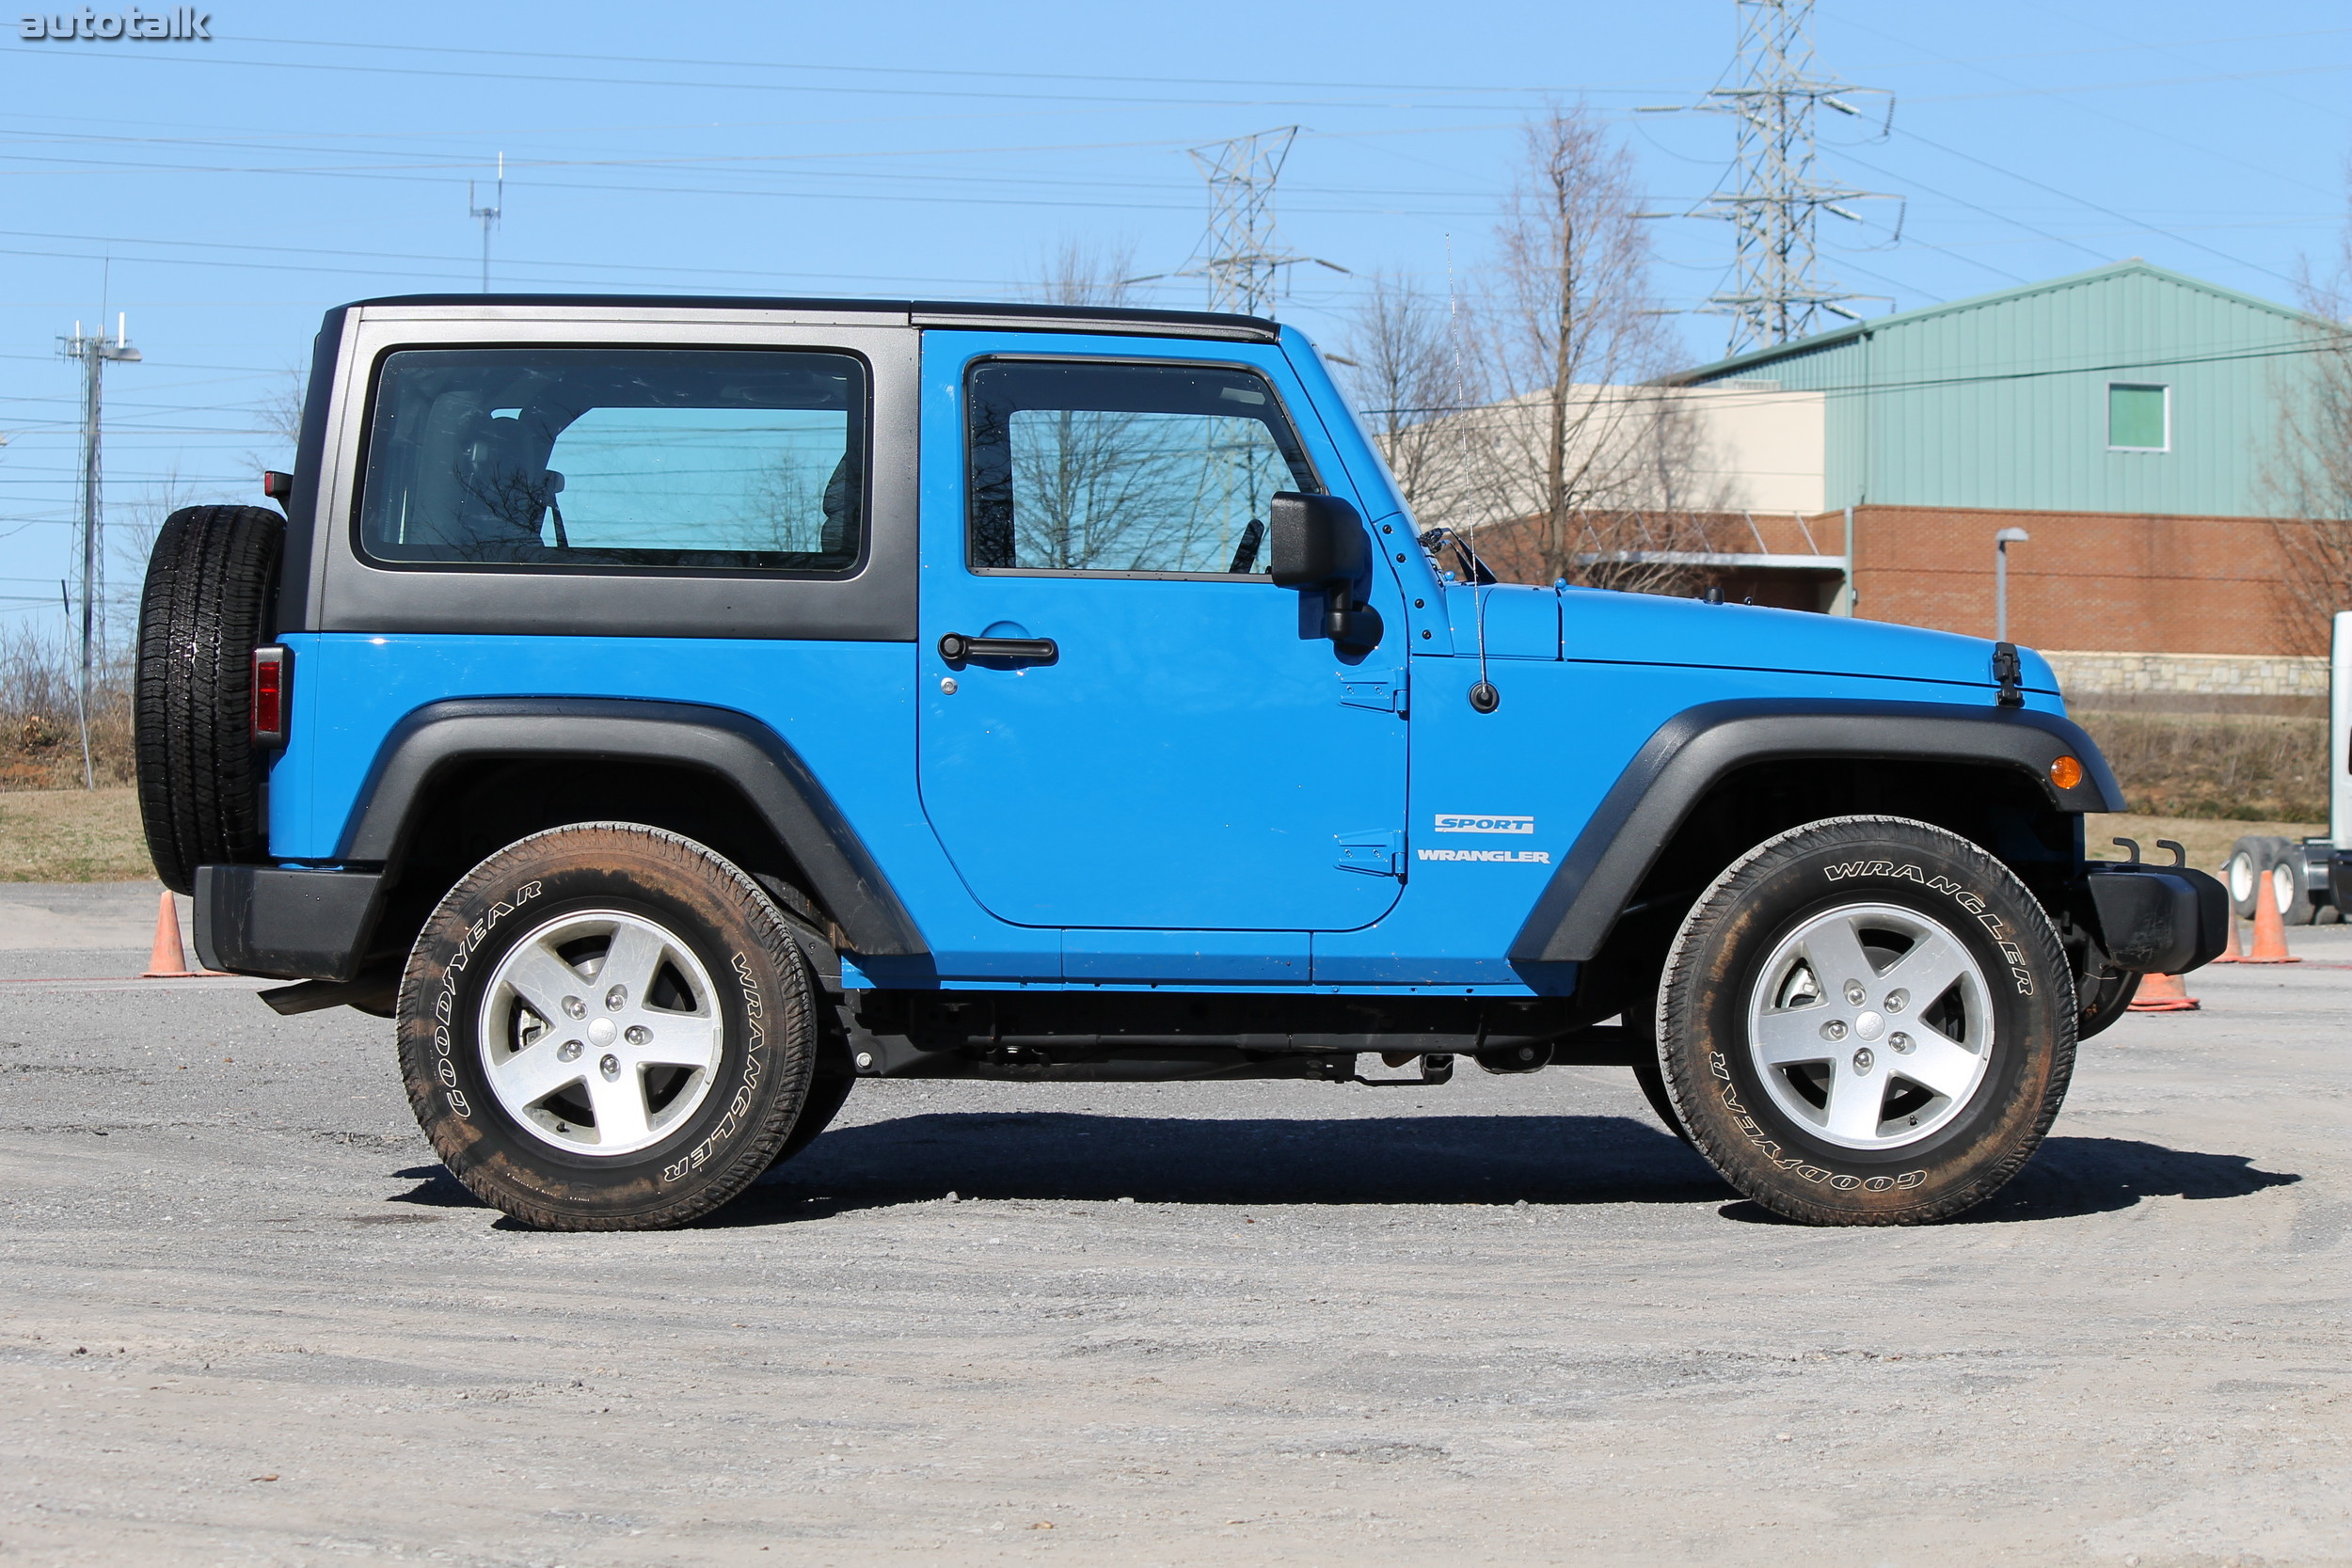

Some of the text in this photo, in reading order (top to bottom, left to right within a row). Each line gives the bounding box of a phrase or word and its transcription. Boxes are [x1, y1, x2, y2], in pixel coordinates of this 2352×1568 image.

[1417, 848, 1551, 864] WRANGLER
[1436, 816, 1534, 832] SPORT
[433, 879, 543, 1118] GOODYEAR
[1823, 860, 2035, 998] WRANGLER
[663, 951, 766, 1183] WRANGLER
[1708, 1050, 1928, 1193] GOODYEAR
